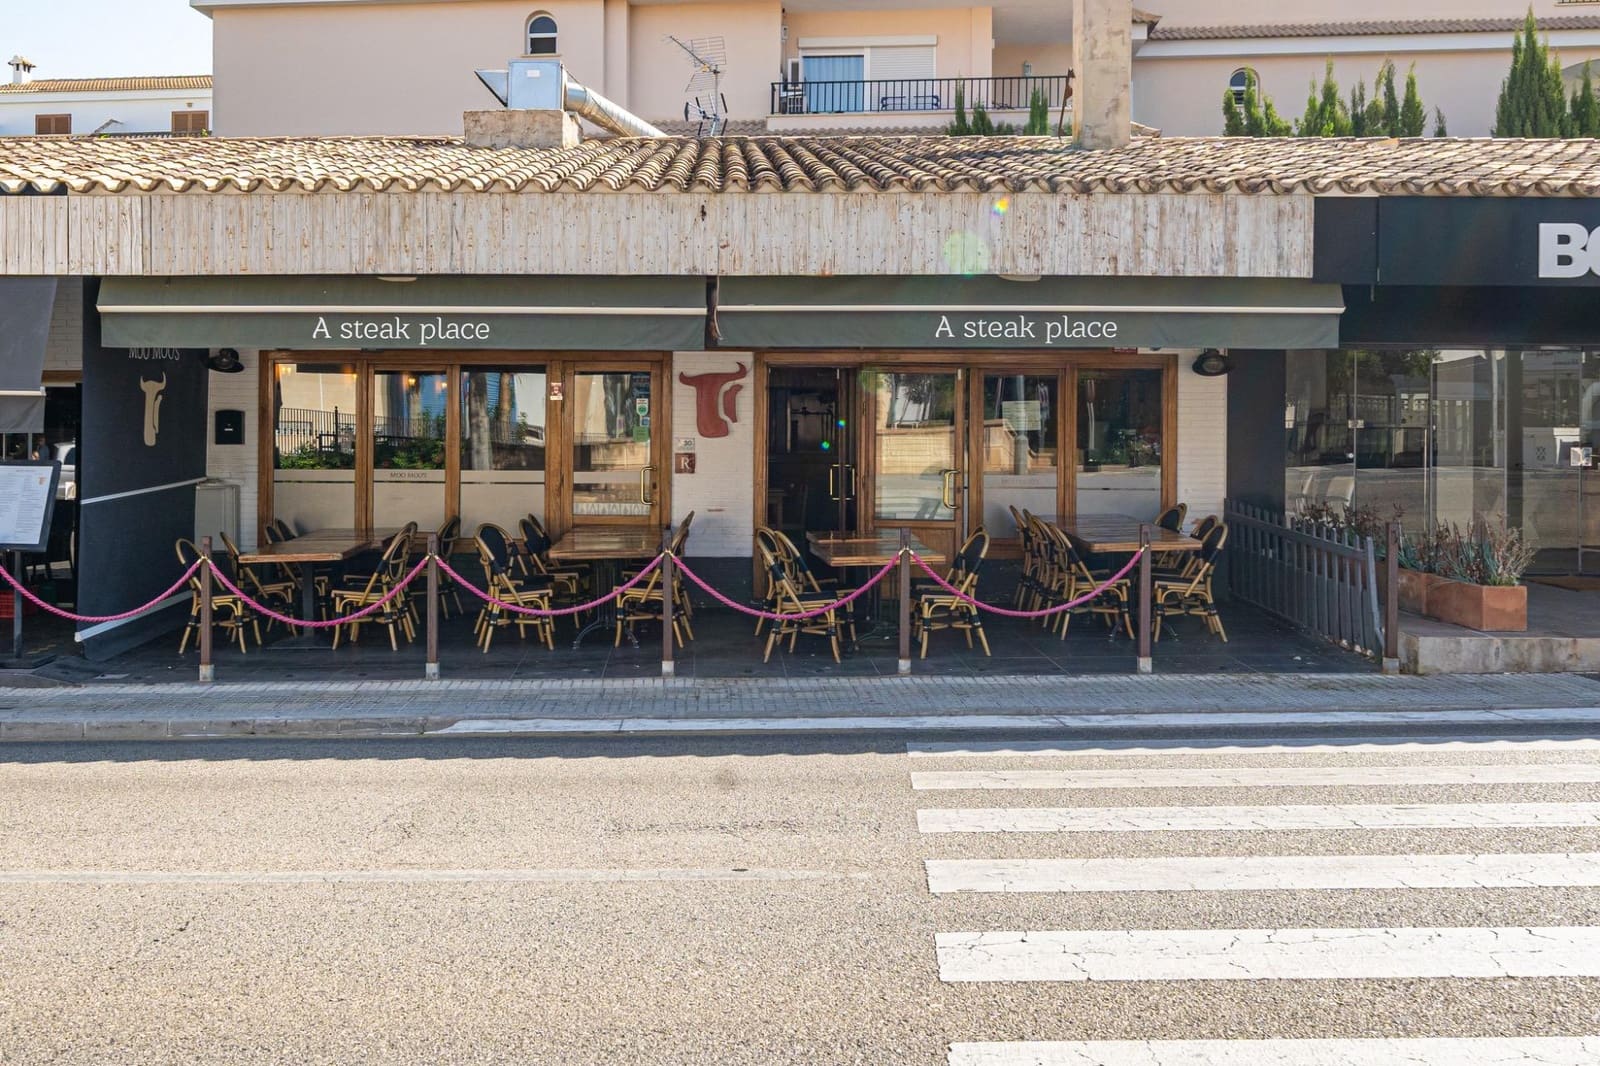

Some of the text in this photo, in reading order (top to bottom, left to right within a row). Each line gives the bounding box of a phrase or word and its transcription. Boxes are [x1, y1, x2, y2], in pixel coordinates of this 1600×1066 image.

[1538, 223, 1600, 278] B
[312, 316, 490, 345] A steak place
[935, 315, 1118, 344] A steak place
[680, 456, 691, 470] R
